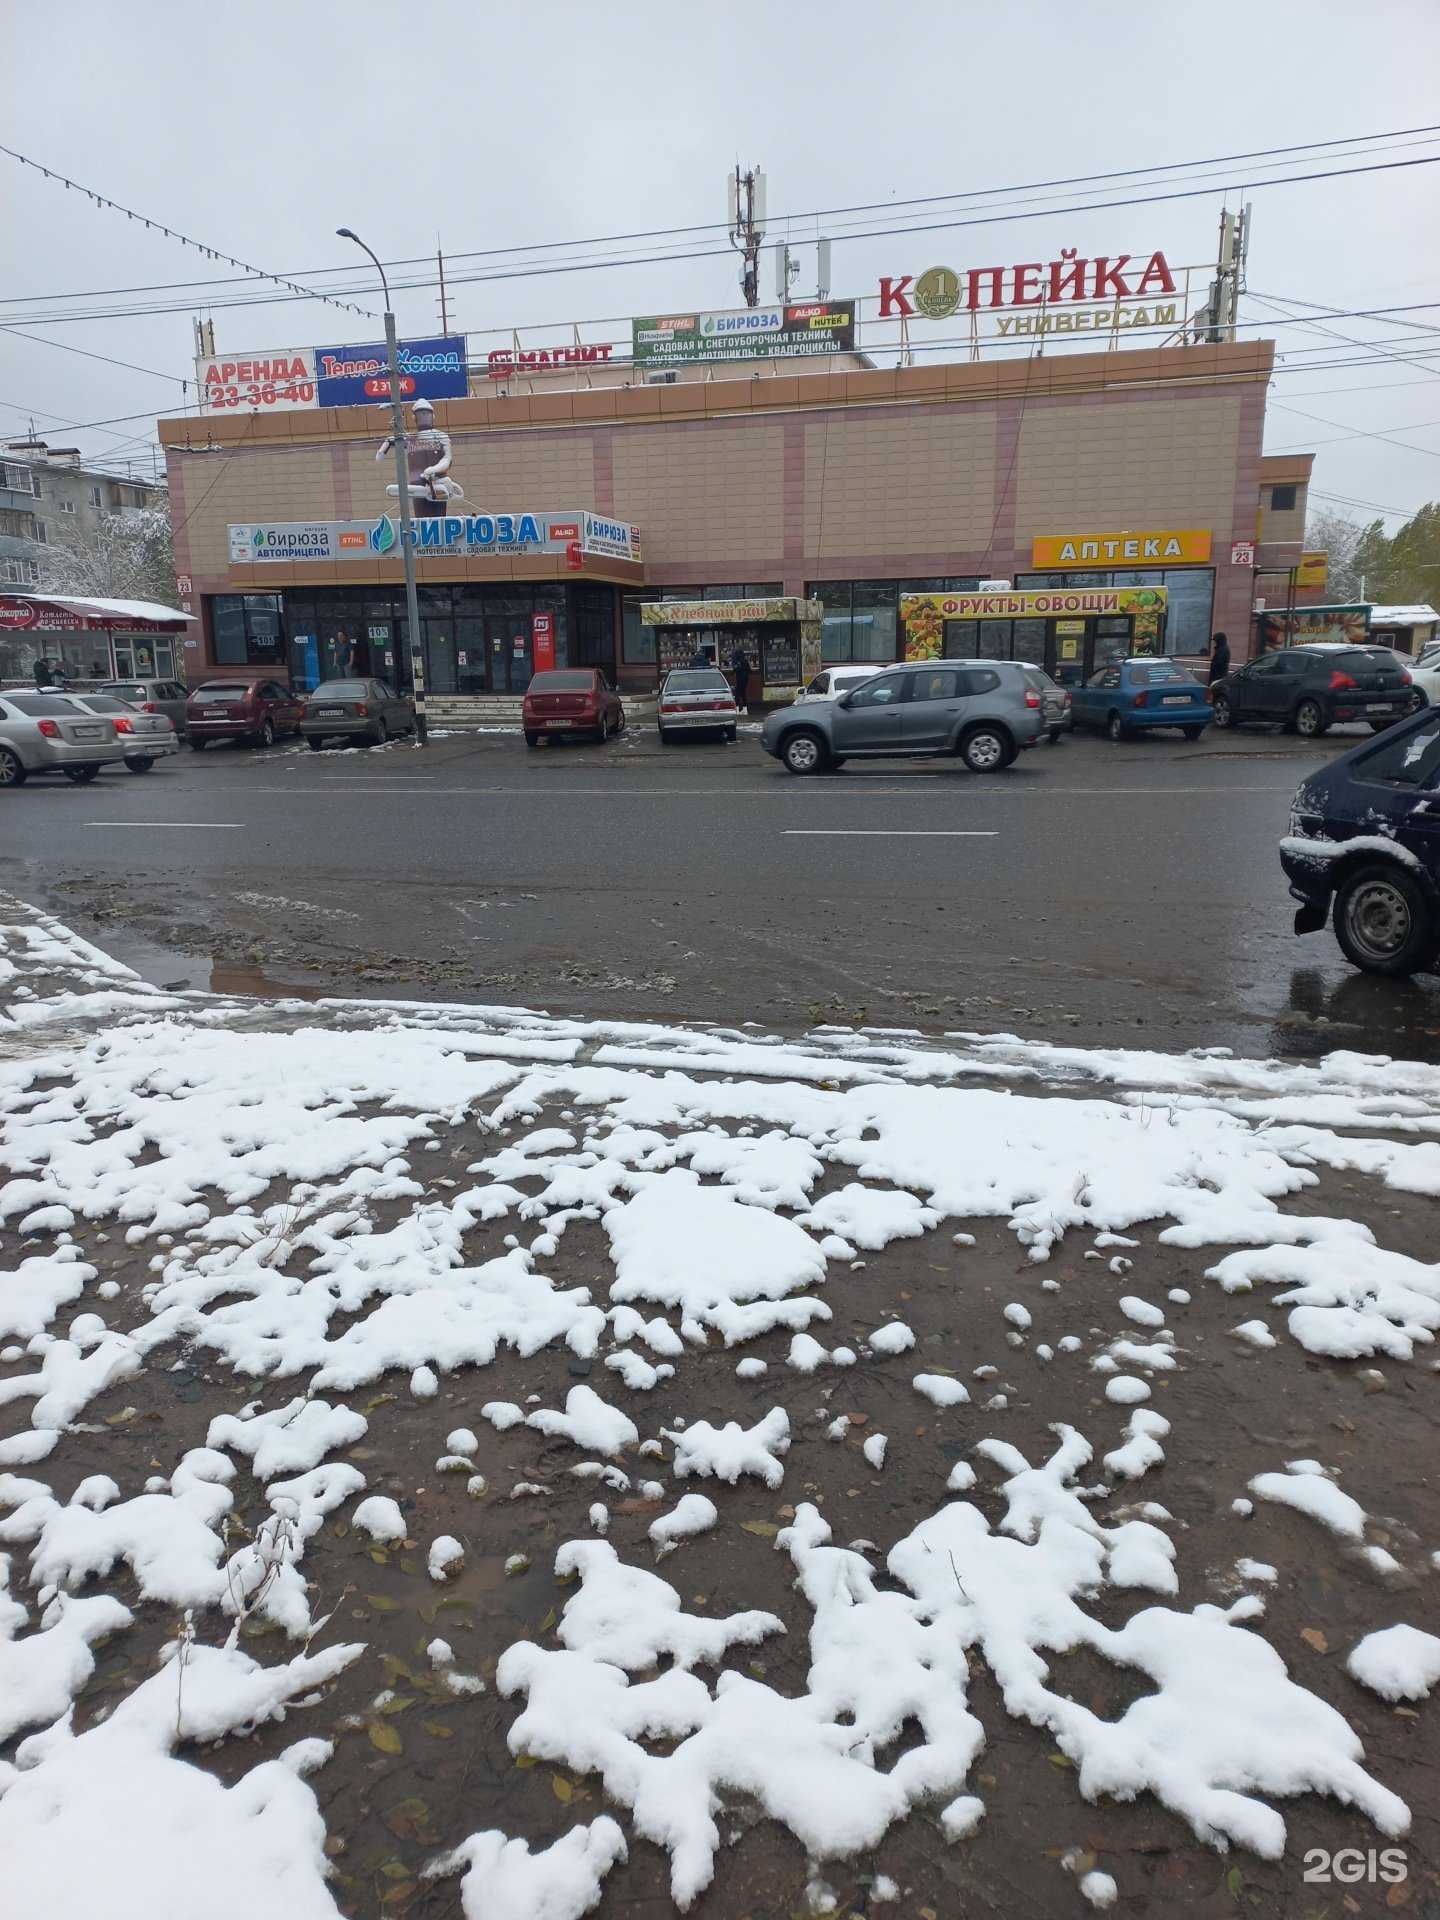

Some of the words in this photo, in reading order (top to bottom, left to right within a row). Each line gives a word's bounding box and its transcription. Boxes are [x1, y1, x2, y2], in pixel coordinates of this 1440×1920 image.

[660, 319, 691, 329] STIHL
[717, 314, 779, 331] БИРЮЗА
[996, 303, 1176, 337] УНИВЕРСАМ
[653, 342, 695, 353] САДОВАЯ
[697, 341, 703, 349] И
[706, 333, 789, 349] СНЕГОУБОРОЧНАЯ
[792, 329, 833, 341] ТЕХНИКА
[699, 347, 756, 359] МОТОЦИКЛЫ
[768, 341, 840, 355] КВАДРОЦИКЛЫ
[395, 349, 460, 374] Холод
[519, 345, 612, 371] МАГНИТ
[205, 357, 307, 384] АРЕНДА
[372, 380, 379, 391] 2
[379, 380, 408, 391] этж
[210, 384, 314, 408] 23-36-40
[267, 531, 329, 548] бирюза
[593, 521, 628, 544] БИРЮЗА
[257, 548, 330, 558] АВТОПРИЦЕПЫ
[1059, 537, 1183, 561] АПТЕКА
[1235, 552, 1249, 563] 23
[180, 583, 190, 592] 23
[671, 603, 735, 619] Хлебный
[942, 594, 1120, 615] ФРУКТЫ-ОВОЩИ
